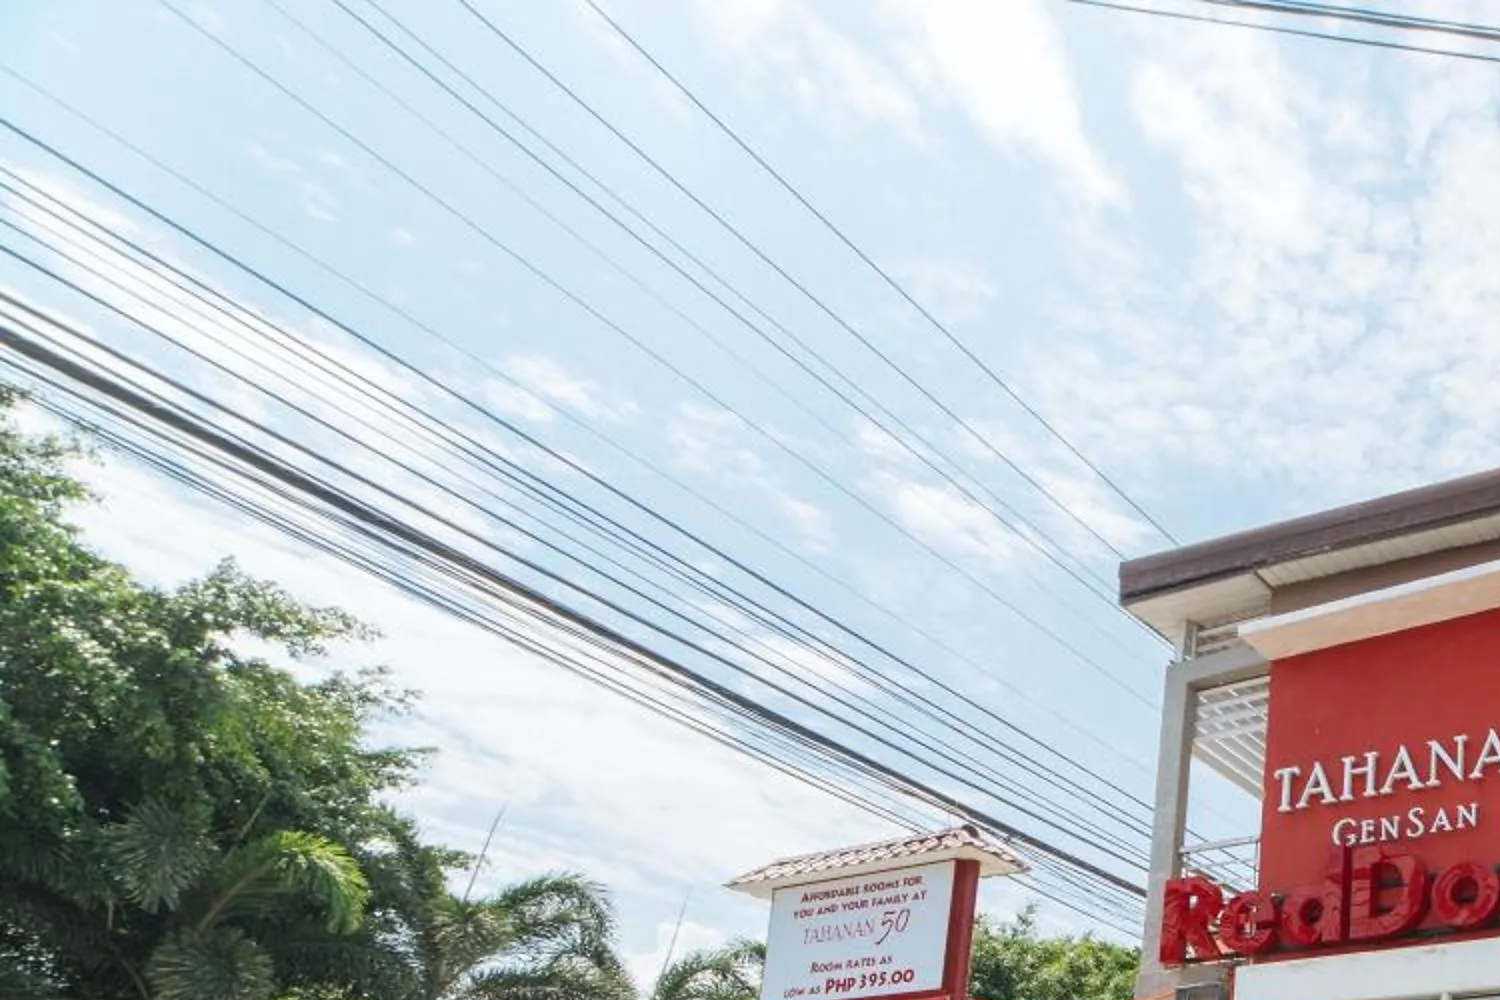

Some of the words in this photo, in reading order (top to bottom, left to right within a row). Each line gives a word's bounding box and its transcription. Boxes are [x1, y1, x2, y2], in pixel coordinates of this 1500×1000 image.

[793, 908, 814, 919] YOU
[816, 904, 839, 916] AND
[841, 900, 869, 912] YOUR
[872, 893, 908, 907] FAMILY
[912, 889, 928, 901] AT
[801, 885, 860, 904] AFFORDABLE
[863, 880, 899, 893] ROOMS
[903, 875, 923, 887] FOR
[803, 919, 876, 945] TAHANAN
[874, 908, 911, 945] 50
[810, 961, 843, 973] ROOM
[846, 957, 875, 969] RATES
[878, 955, 893, 965] AS
[783, 988, 805, 999] LOW
[809, 985, 821, 996] AS
[824, 977, 857, 995] PHP
[859, 968, 916, 990] 395.00
